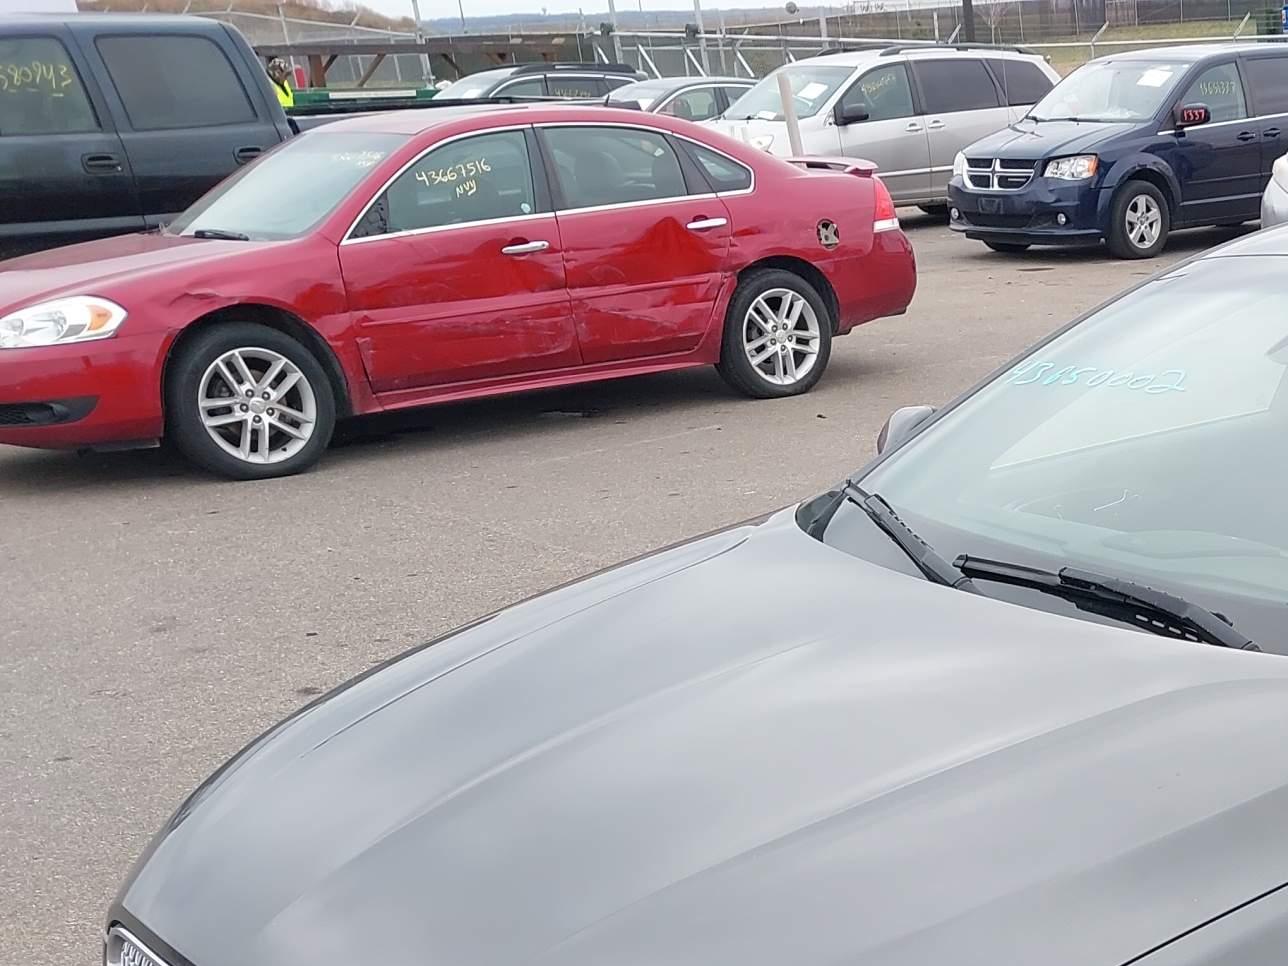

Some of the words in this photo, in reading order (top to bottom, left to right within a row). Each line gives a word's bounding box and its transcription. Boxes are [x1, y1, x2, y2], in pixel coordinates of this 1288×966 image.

[1183, 109, 1205, 121] 1337
[415, 158, 492, 187] 43667516
[1005, 361, 1186, 394] 43650002
